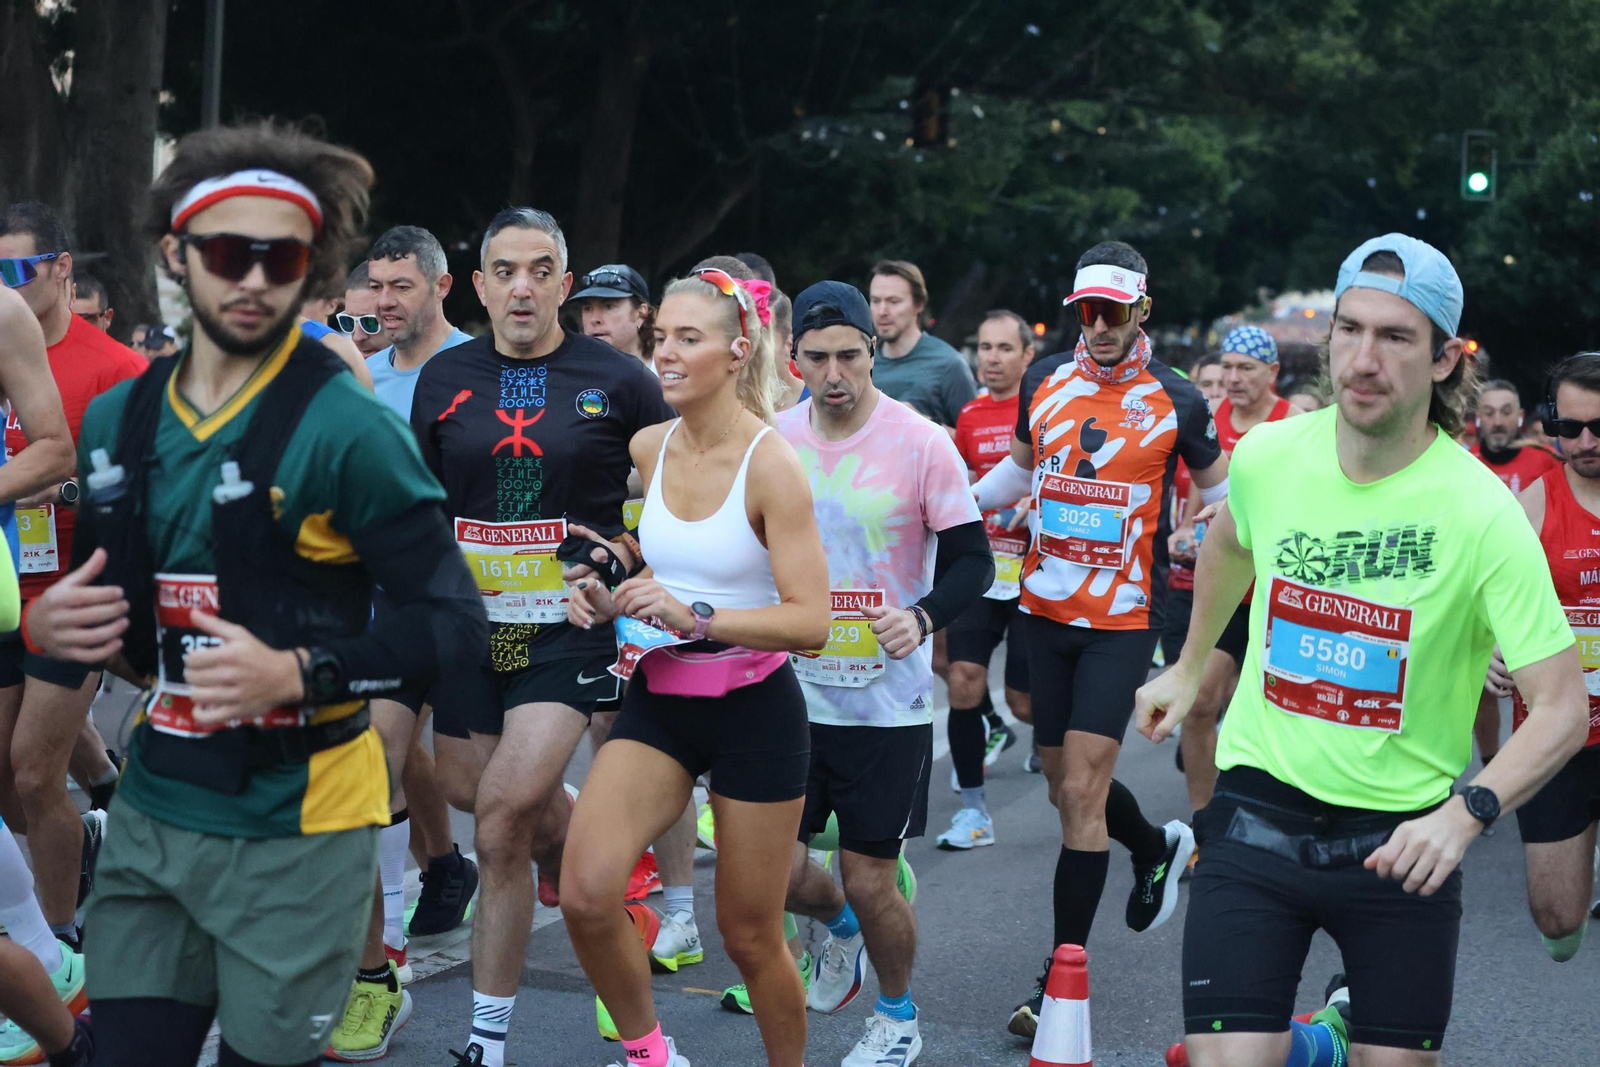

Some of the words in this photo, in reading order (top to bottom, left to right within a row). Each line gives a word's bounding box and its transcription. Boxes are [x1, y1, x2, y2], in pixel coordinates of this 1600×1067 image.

[1061, 481, 1124, 501] GENERALI
[1058, 508, 1101, 528] 3026
[483, 526, 556, 543] GENERALI
[1066, 526, 1091, 535] SUAREZ
[1326, 527, 1438, 585] RUN
[478, 559, 542, 578] 16147
[1580, 567, 1600, 585] MÁ
[830, 595, 876, 609] ERALI
[1305, 593, 1402, 632] GENERALI
[1299, 633, 1366, 671] 5580
[1316, 663, 1347, 679] SIMON
[1353, 699, 1381, 709] 42K
